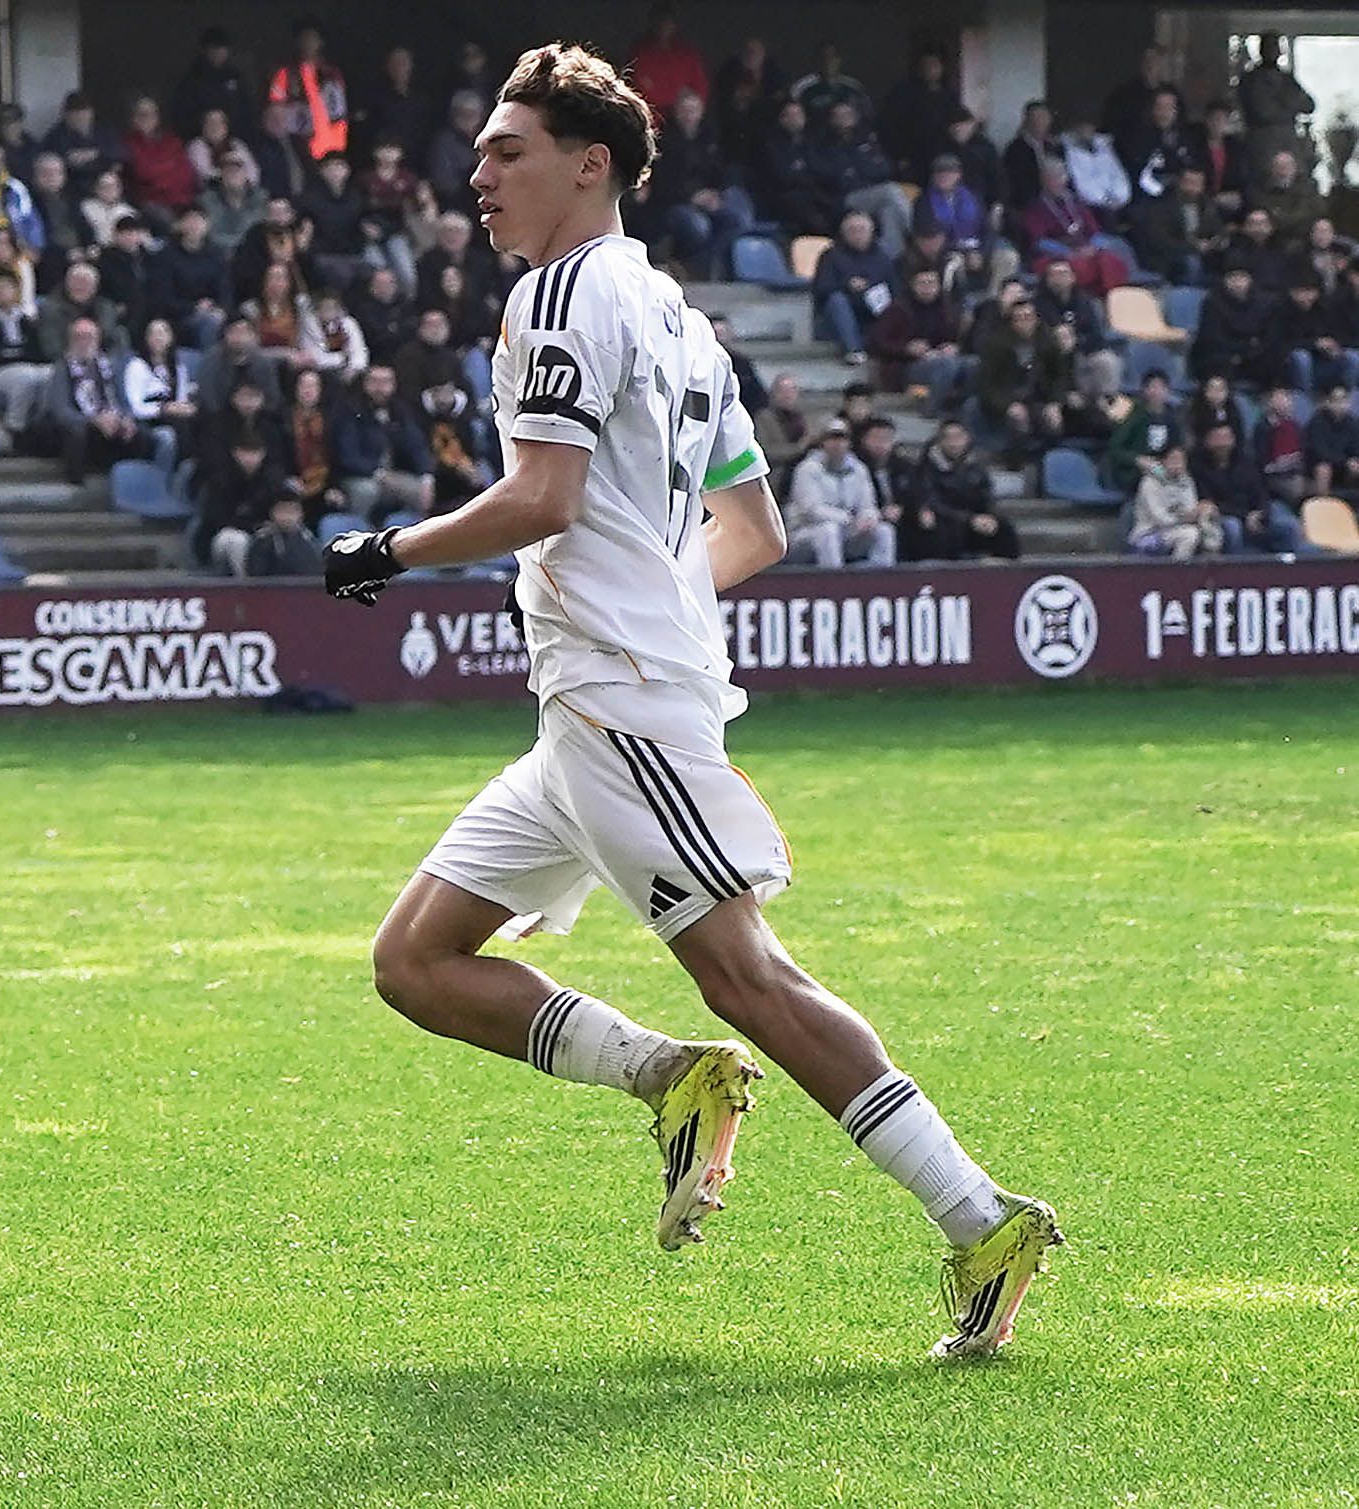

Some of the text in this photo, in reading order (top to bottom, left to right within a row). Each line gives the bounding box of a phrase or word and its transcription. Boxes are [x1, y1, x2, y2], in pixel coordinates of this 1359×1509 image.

[34, 597, 207, 635] CONSERVAS
[437, 611, 527, 653] VER
[719, 585, 971, 669] FEDERACIÓN
